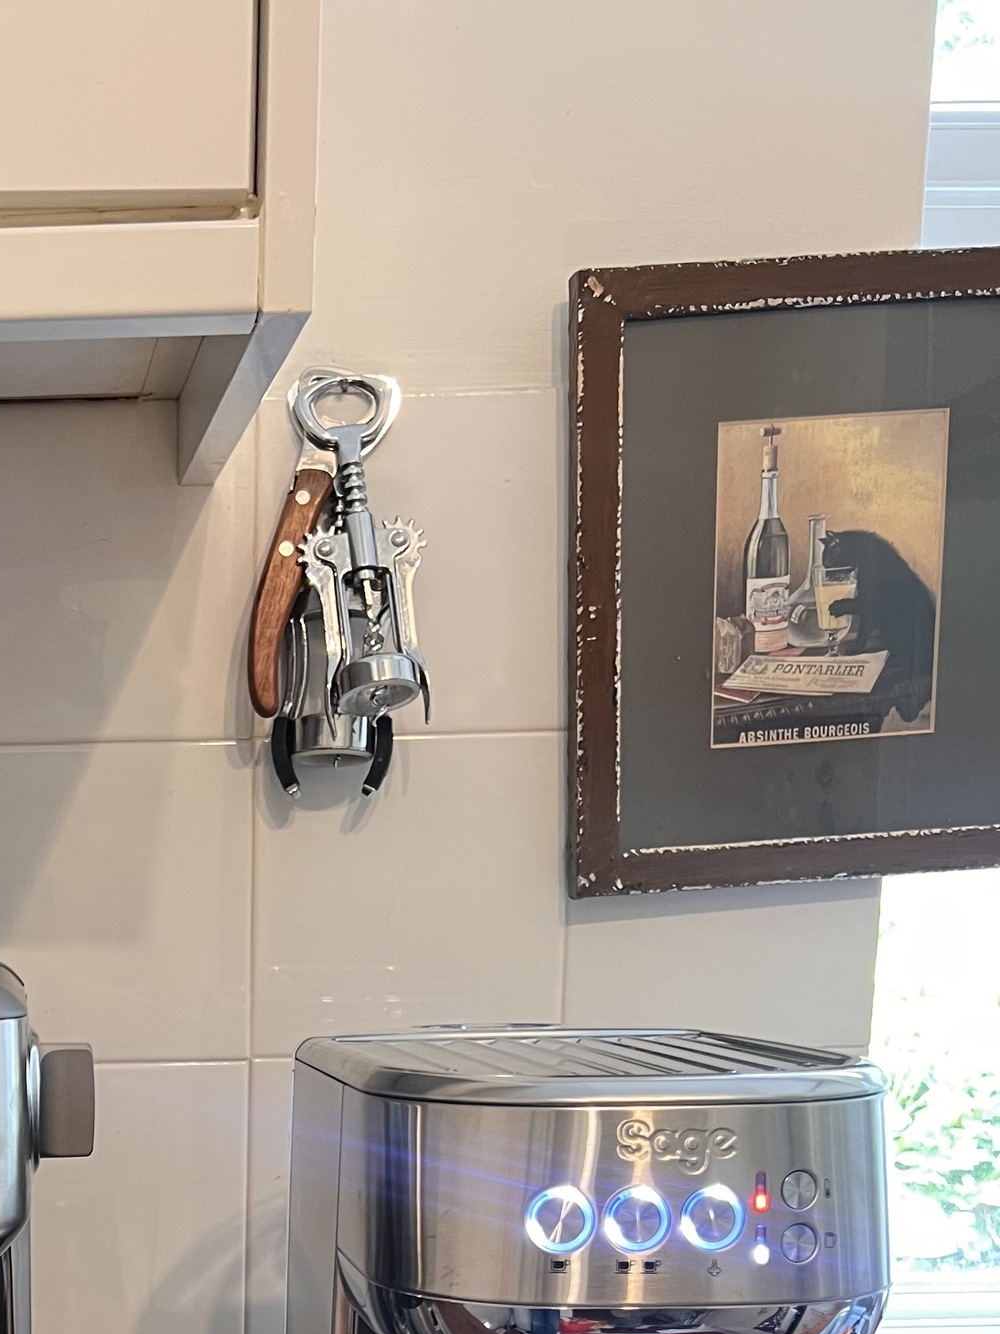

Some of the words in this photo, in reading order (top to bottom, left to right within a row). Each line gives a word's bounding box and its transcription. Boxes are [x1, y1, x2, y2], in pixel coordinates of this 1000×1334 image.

[771, 663, 865, 677] PONTARLIER
[738, 727, 799, 744] ABSINTHE
[803, 722, 870, 740] BOURGEOIS
[616, 1119, 738, 1175] Sage
